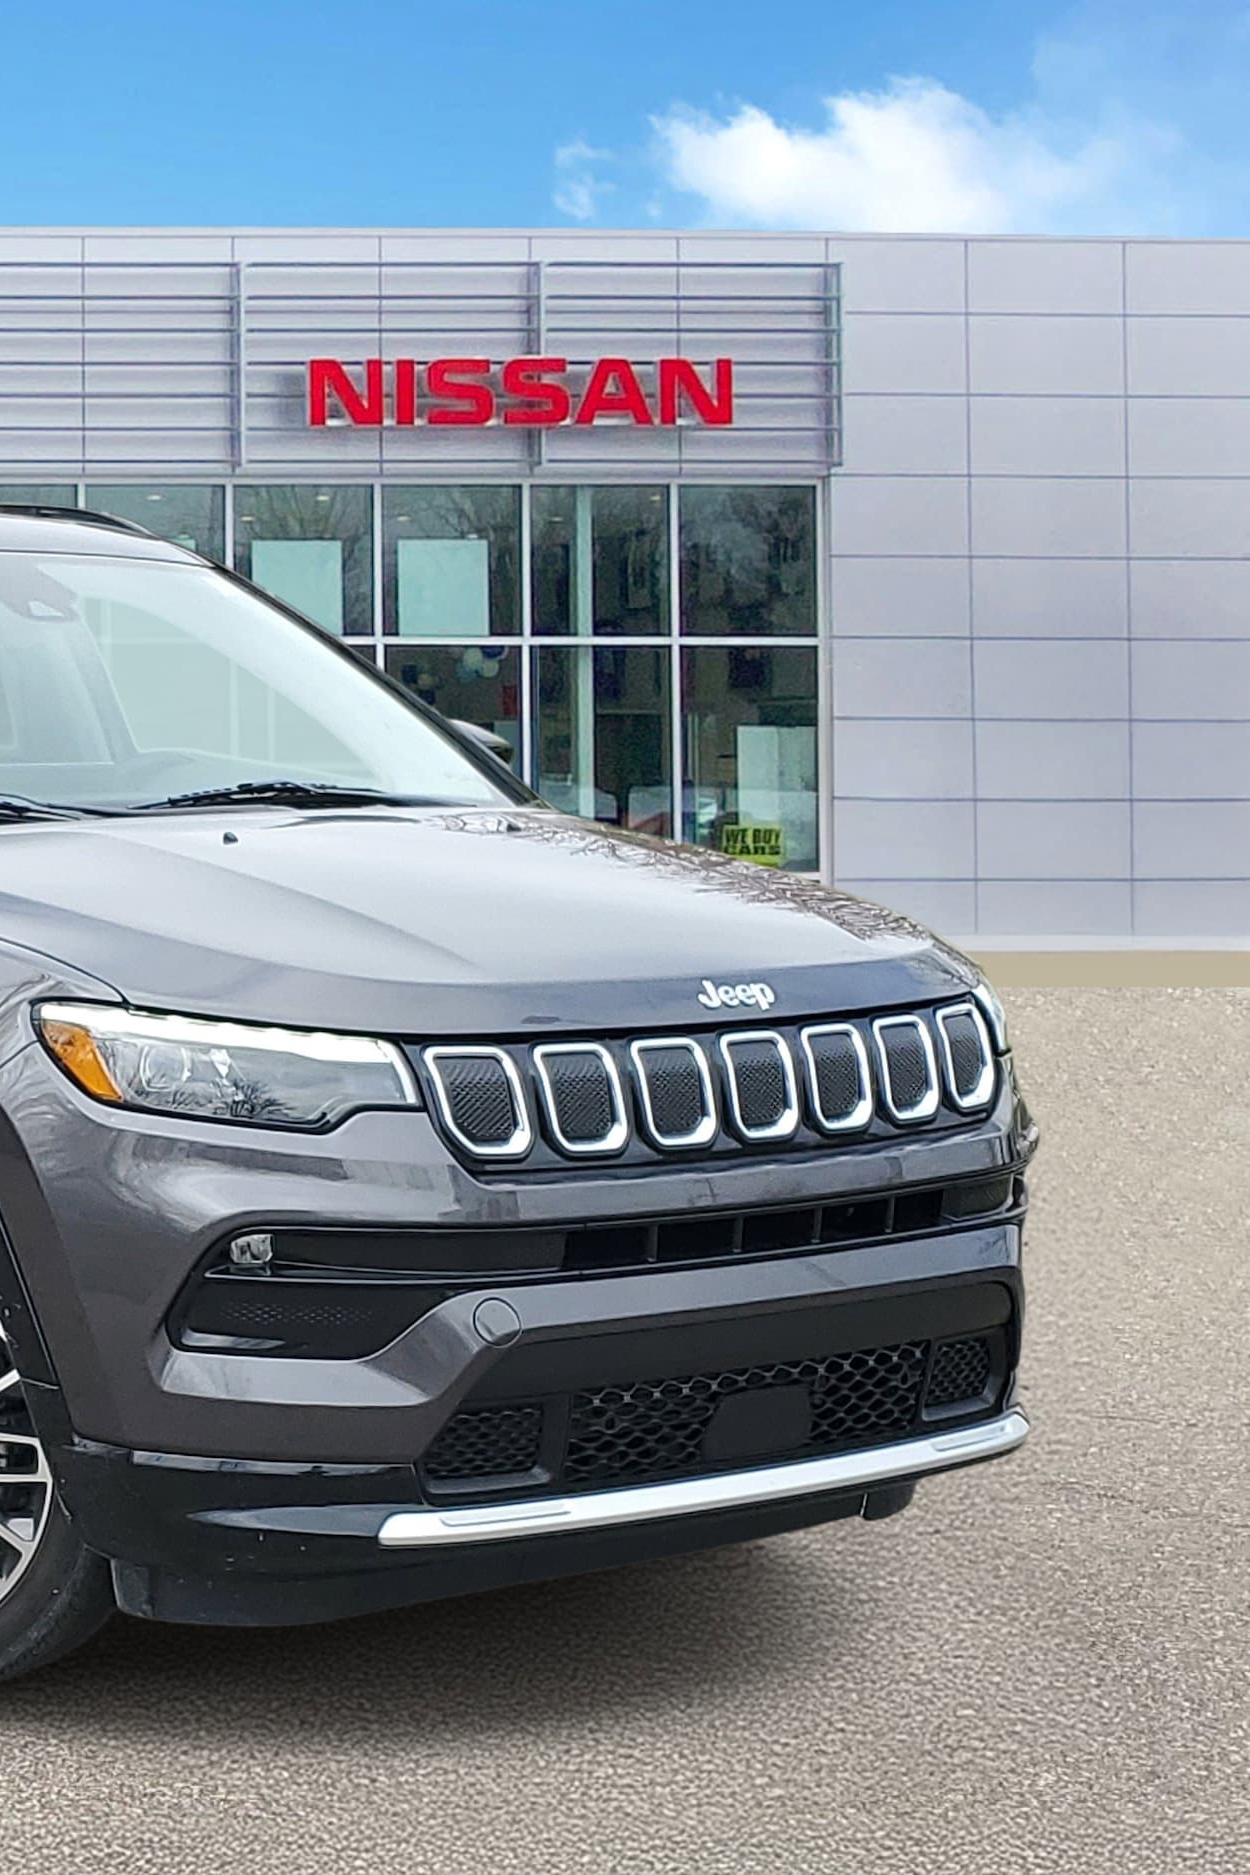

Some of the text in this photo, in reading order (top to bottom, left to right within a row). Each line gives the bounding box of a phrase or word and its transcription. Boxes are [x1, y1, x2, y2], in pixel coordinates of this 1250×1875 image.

[307, 358, 733, 426] NISSAN
[724, 828, 781, 844] WE BUY
[697, 979, 775, 1011] Jeep
